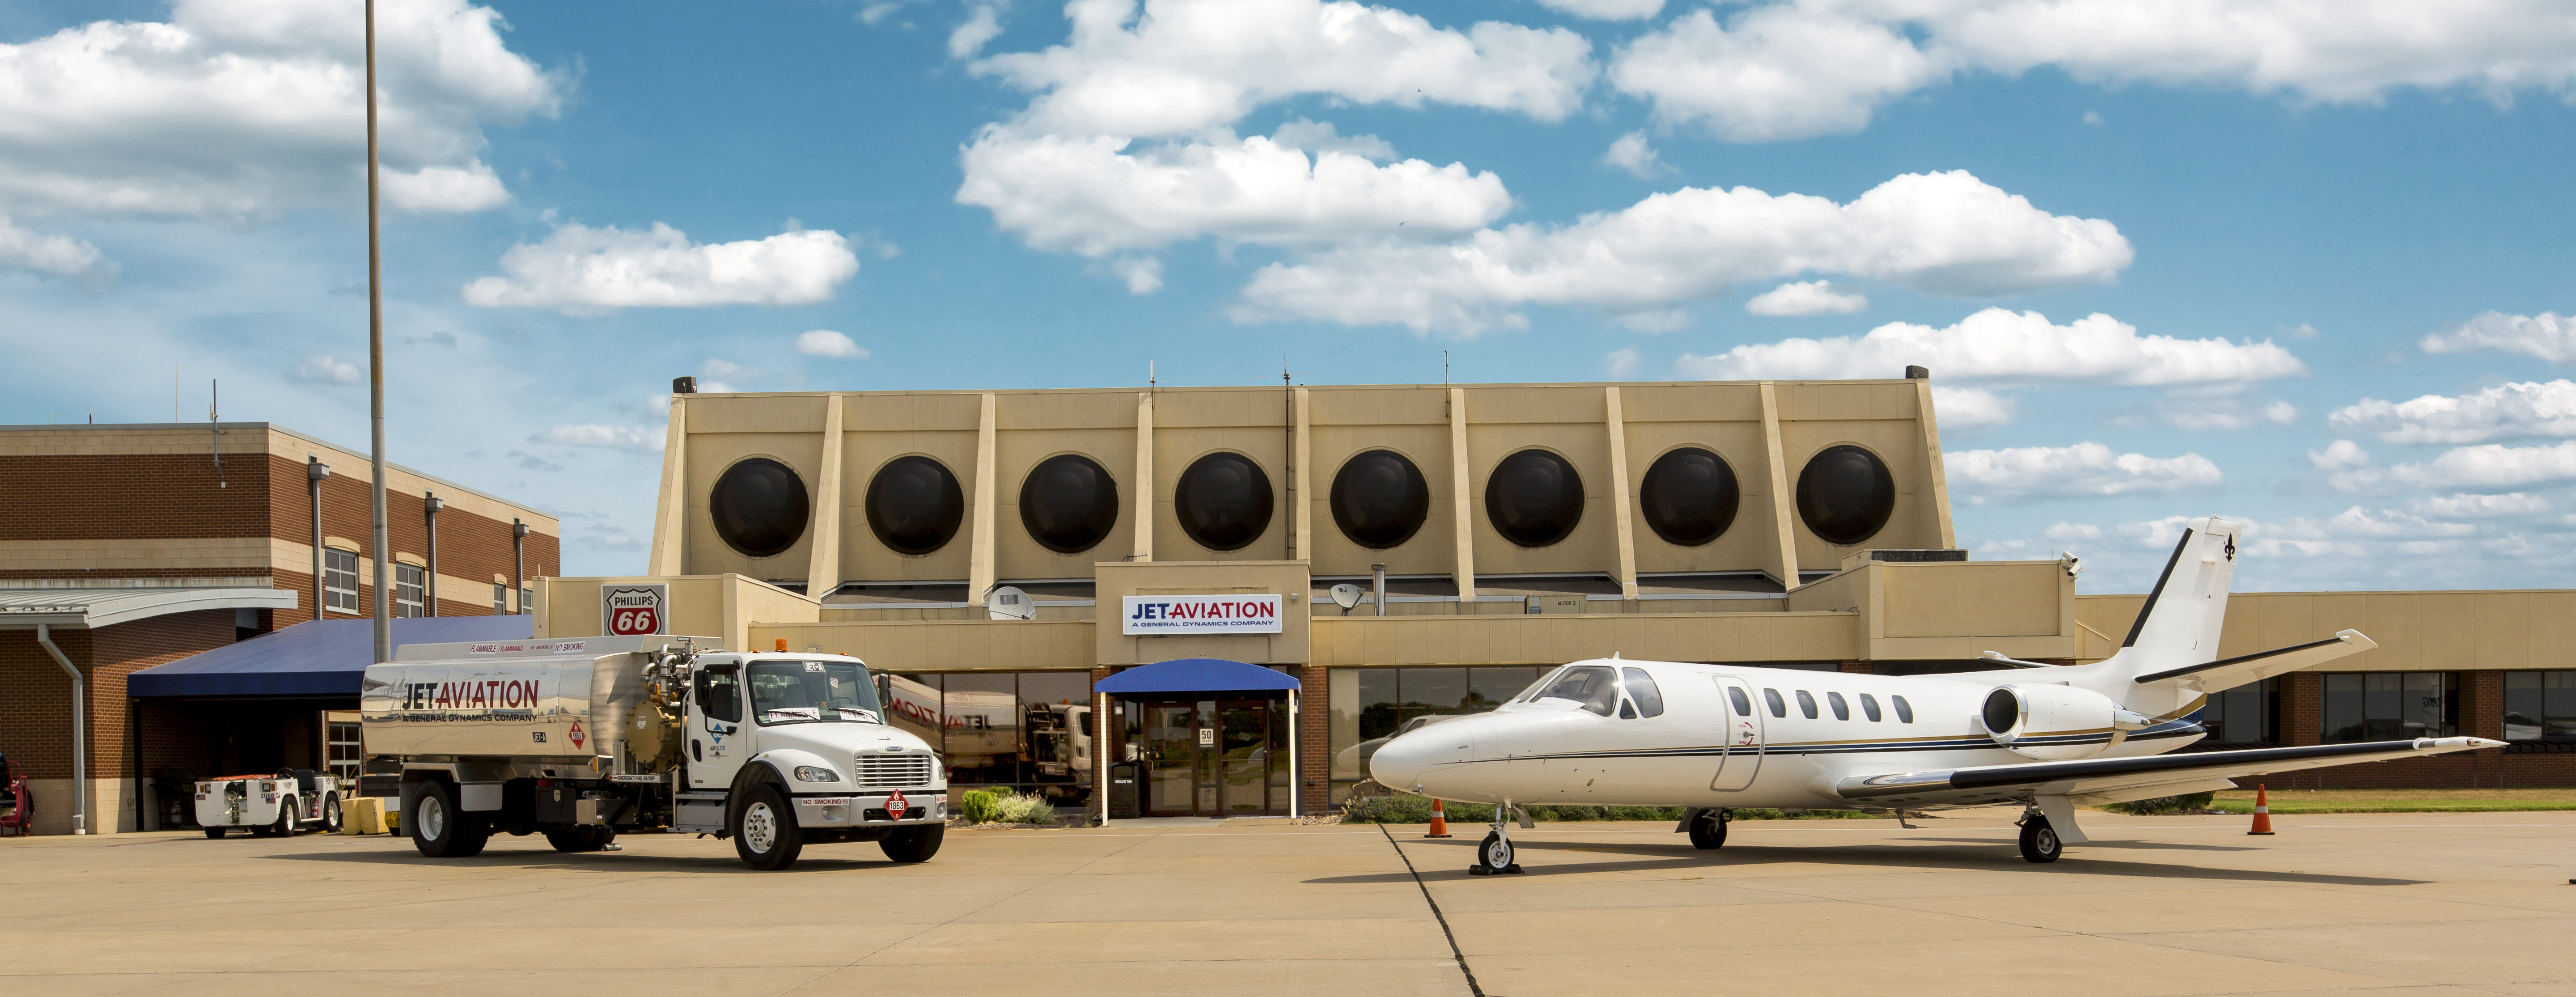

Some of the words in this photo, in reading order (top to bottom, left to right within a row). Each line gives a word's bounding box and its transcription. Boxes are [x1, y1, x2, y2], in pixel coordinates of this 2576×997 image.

[615, 596, 653, 606] PHILLIPS
[1003, 595, 1014, 604] WSI
[617, 611, 651, 631] 66
[470, 645, 497, 653] FLAMMABLE
[563, 642, 584, 652] SMOKING
[805, 663, 824, 671] JET-A
[534, 733, 546, 742] JET-A
[1202, 730, 1212, 739] 50
[890, 802, 904, 810] 1863
